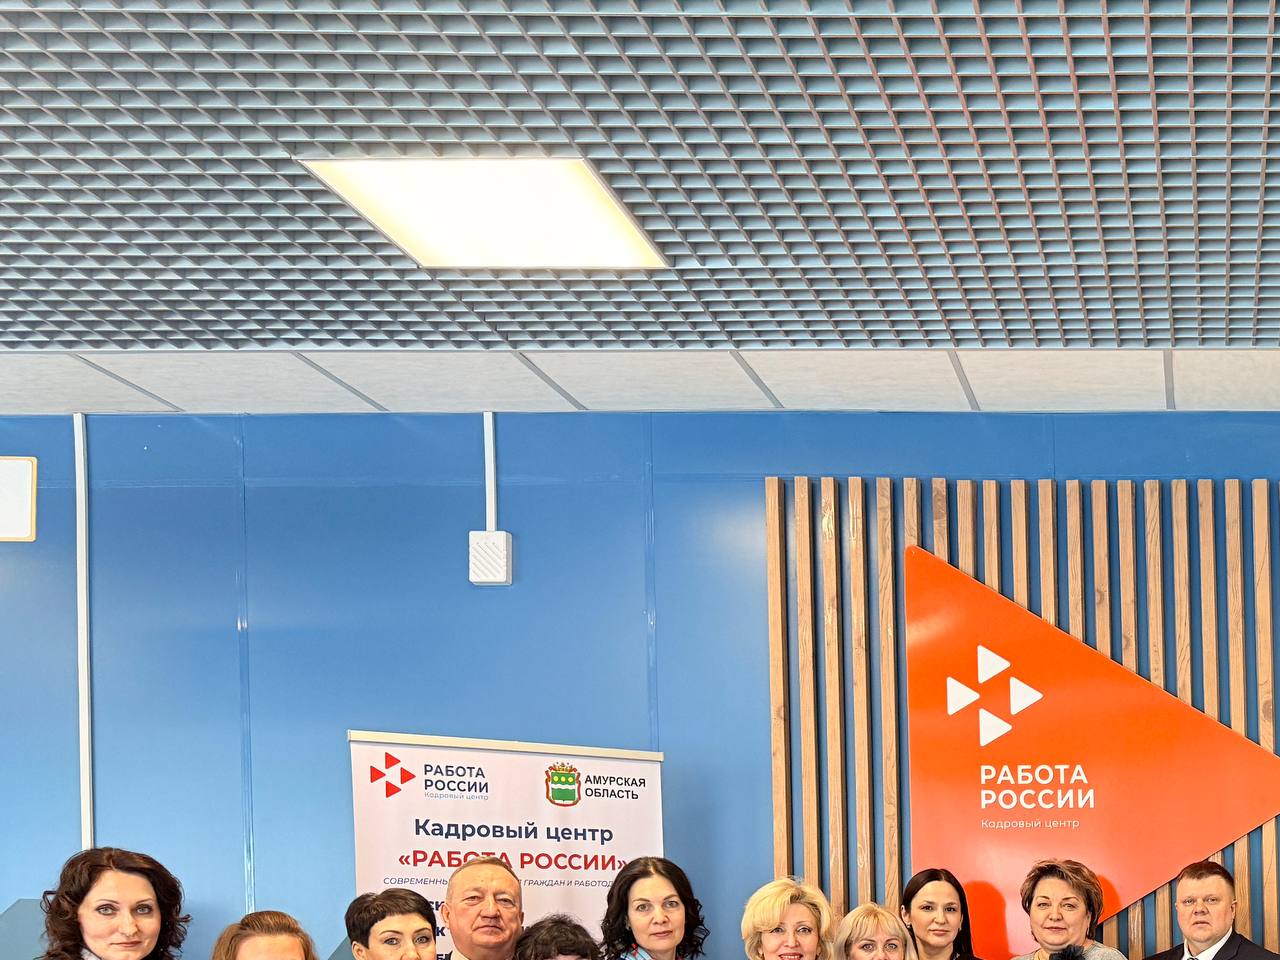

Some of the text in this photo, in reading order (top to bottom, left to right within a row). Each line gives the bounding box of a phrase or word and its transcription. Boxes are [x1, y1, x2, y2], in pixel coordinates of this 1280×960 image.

[424, 764, 486, 779] РАБОТА
[980, 764, 1088, 784] РАБОТА
[424, 778, 489, 793] РОССИИ
[584, 774, 646, 788] АМУРСКАЯ
[425, 791, 464, 799] Кадровый
[584, 787, 639, 800] ОБЛАСТЬ
[980, 788, 1095, 809] РОССИИ
[981, 818, 1080, 829] Кадровый центр
[414, 818, 614, 845] Кадровый центр
[519, 852, 628, 871] РОССИИ»
[523, 879, 565, 887] ГРАЖДАН
